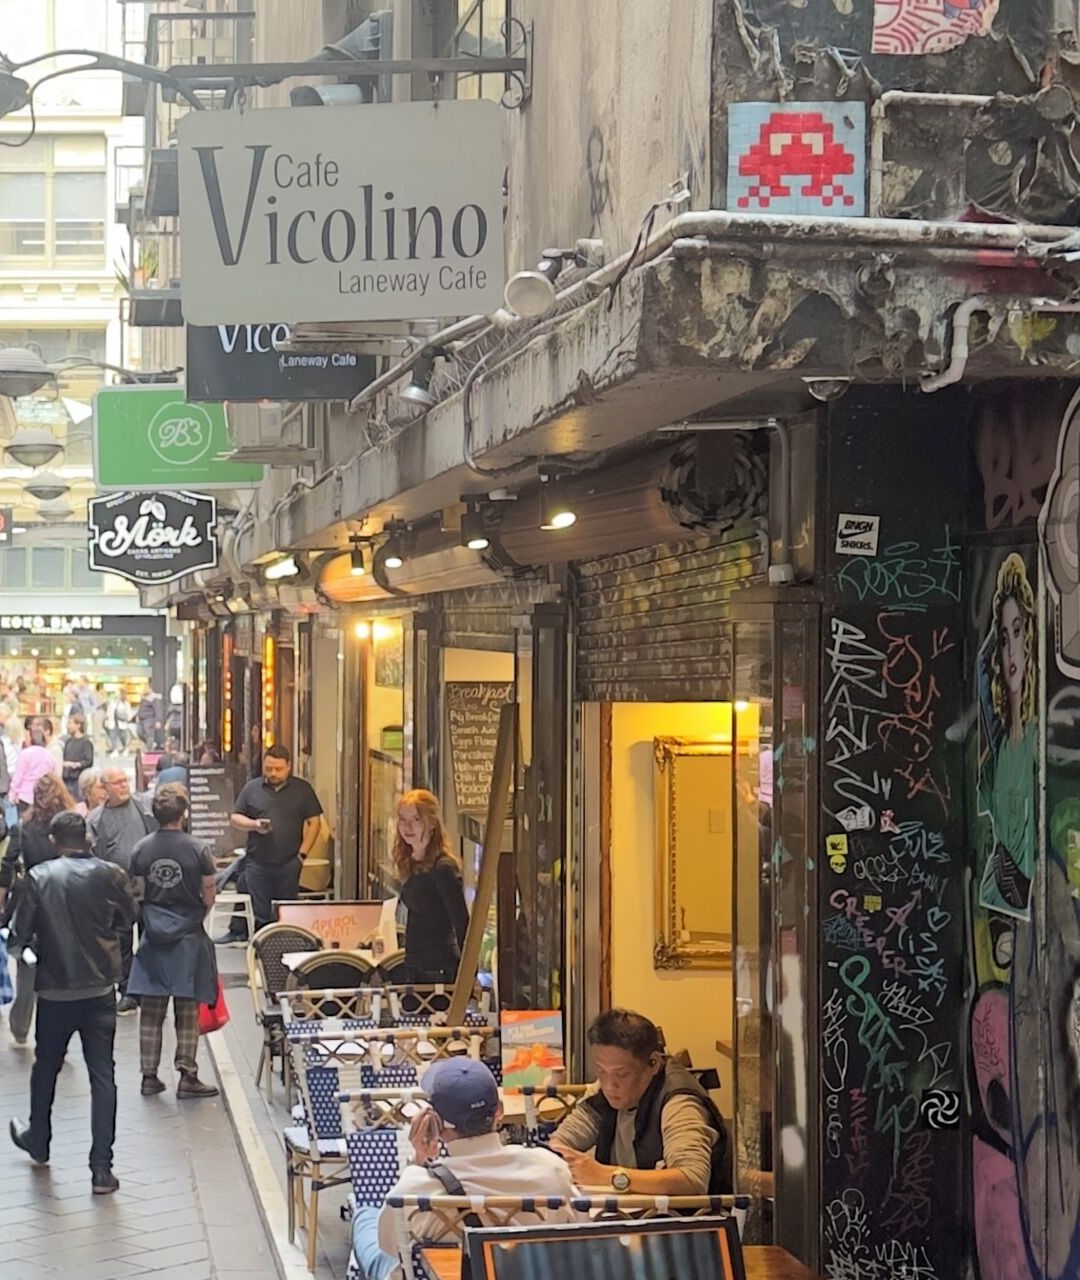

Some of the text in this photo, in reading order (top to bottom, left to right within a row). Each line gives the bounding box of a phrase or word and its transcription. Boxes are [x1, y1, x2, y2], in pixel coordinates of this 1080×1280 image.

[274, 152, 340, 189] Cafe
[191, 144, 489, 267] Vicolino
[338, 265, 488, 297] Laneway Cafe
[219, 323, 291, 354] Vico
[282, 353, 357, 368] Laneway Cafe
[0, 616, 102, 629] KOKO BLACK
[311, 915, 358, 931] APEROL
